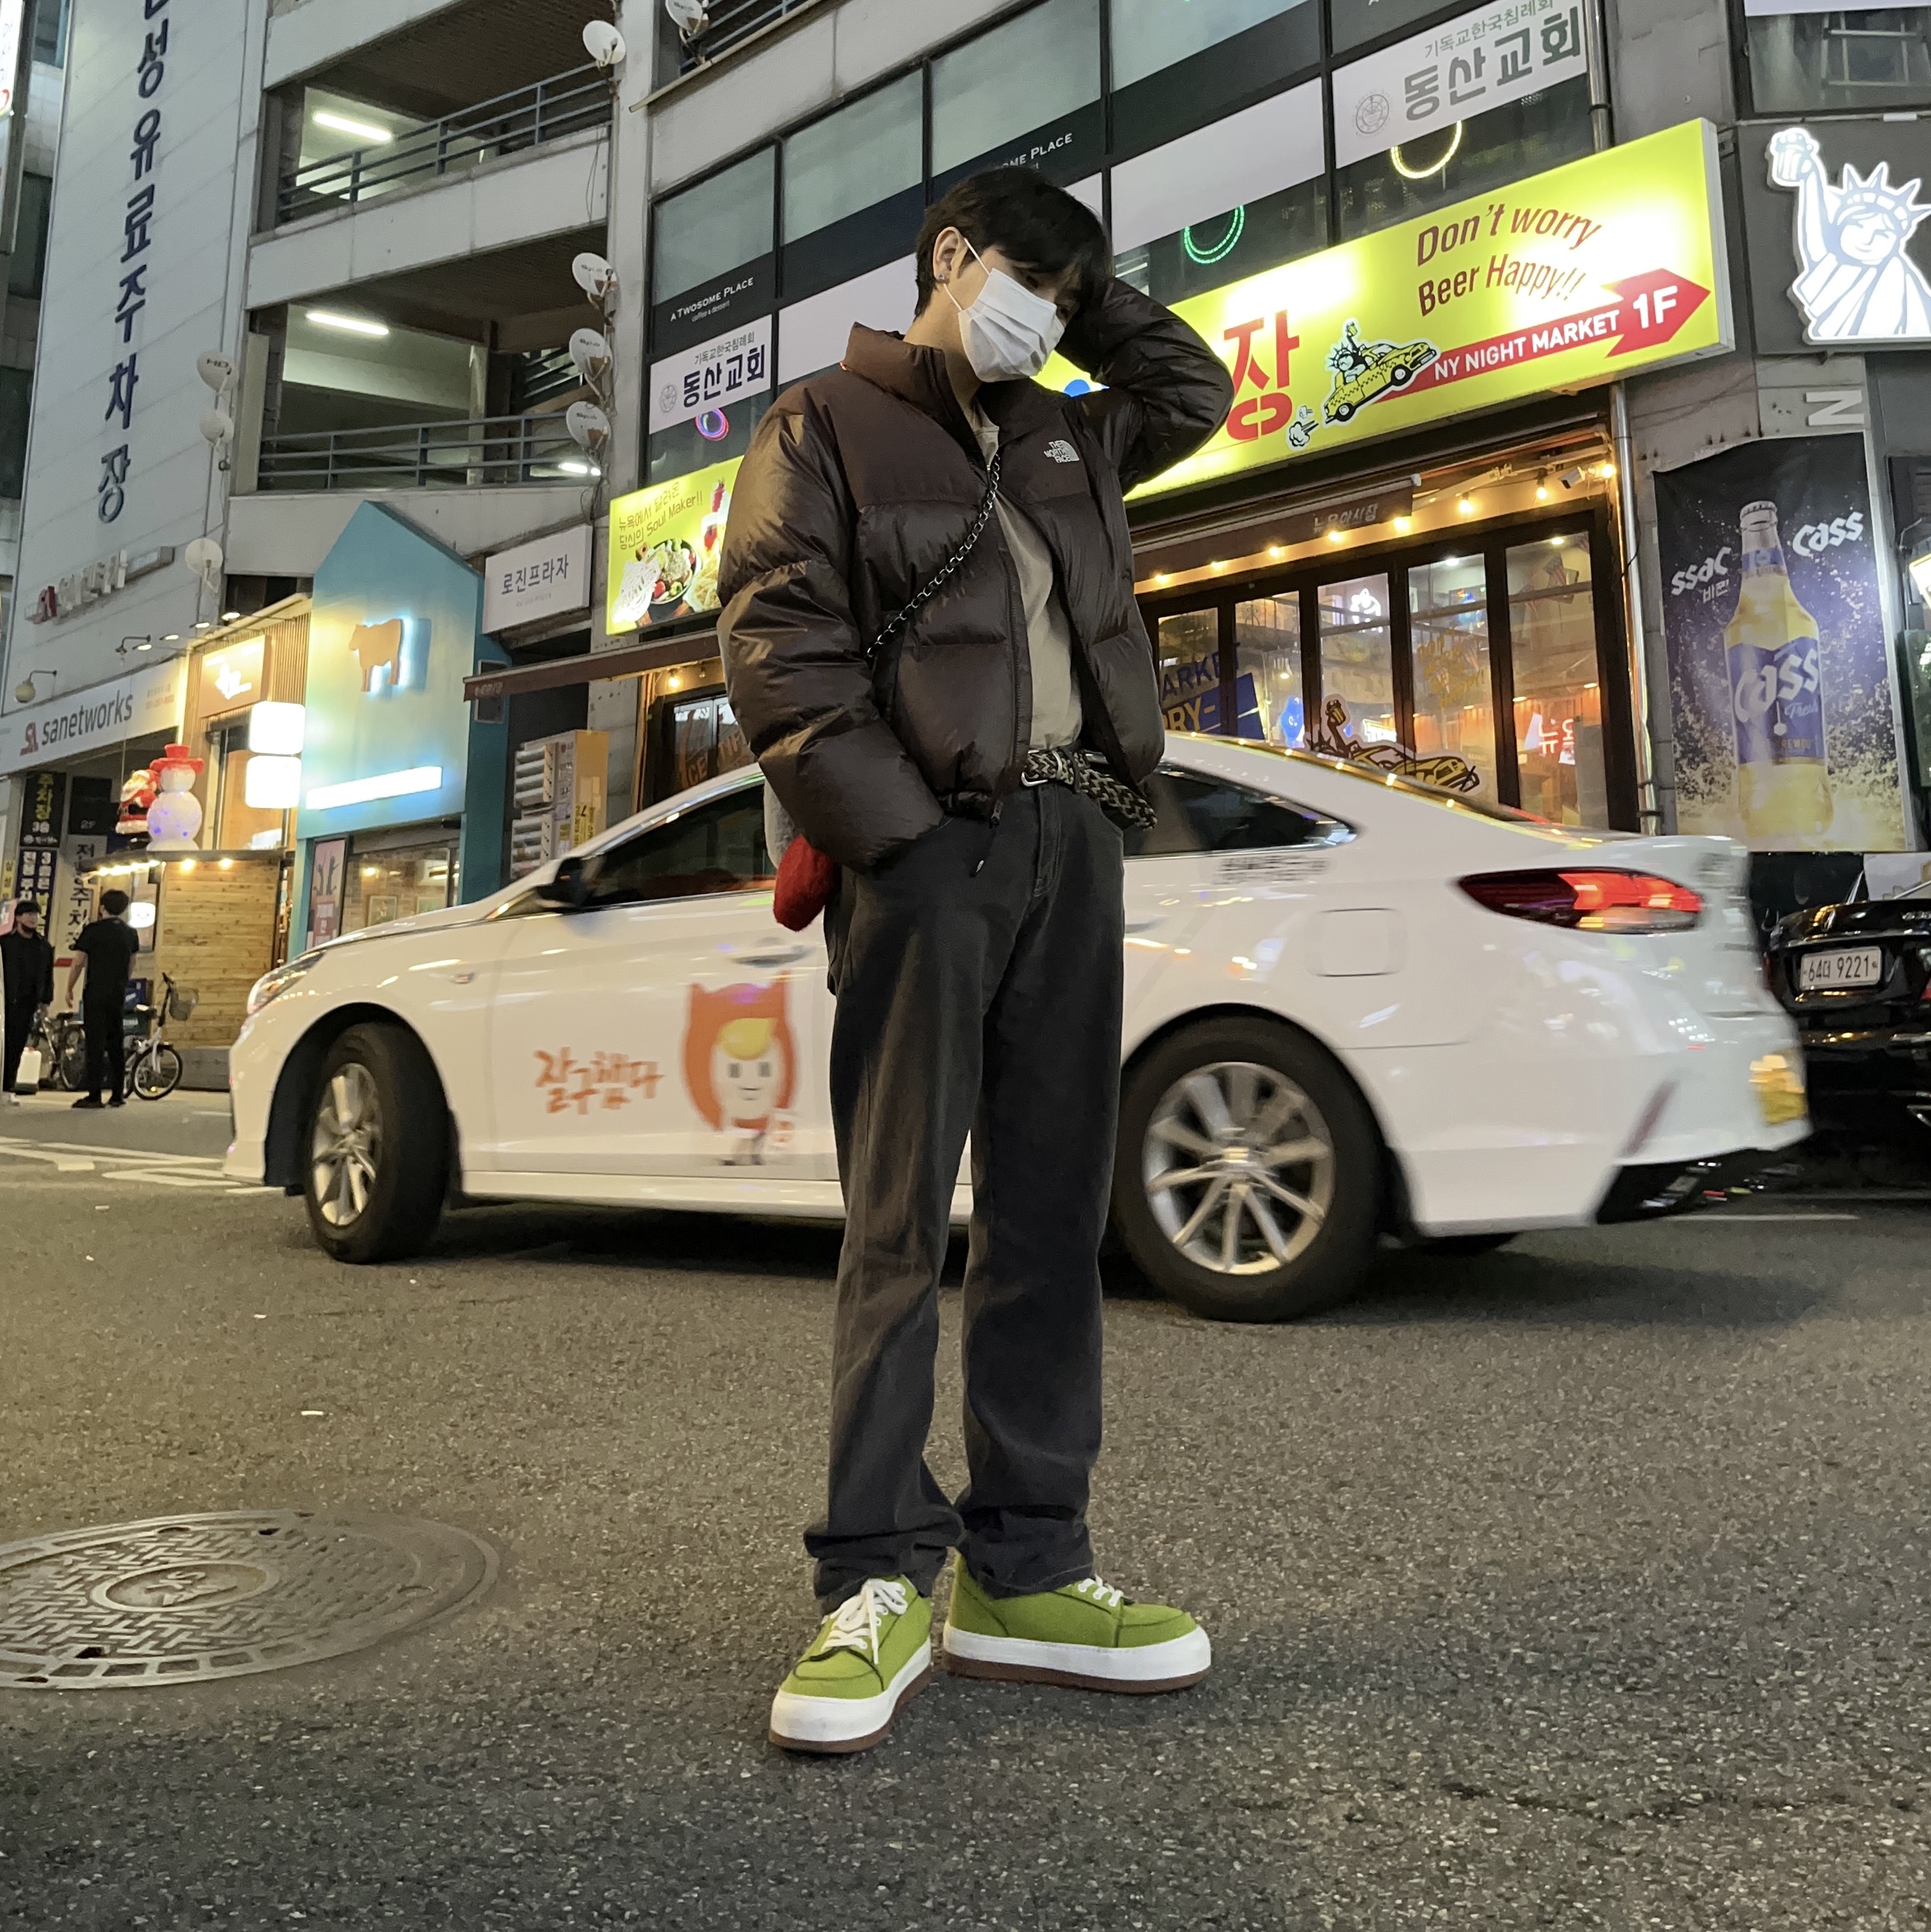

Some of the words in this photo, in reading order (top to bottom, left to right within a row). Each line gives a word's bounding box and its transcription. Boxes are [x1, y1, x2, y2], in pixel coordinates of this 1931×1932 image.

[1404, 6, 1581, 121] 동산교회
[1030, 132, 1073, 160] PLACE
[1417, 203, 1506, 267] Don't
[1510, 208, 1603, 250] worry
[670, 312, 677, 322] A
[723, 277, 755, 298] PLACE
[1418, 266, 1480, 317] Beer
[1485, 254, 1586, 301] Happy!!
[693, 331, 755, 365] 기독교한국침례회
[1434, 356, 1460, 381] NY
[1465, 338, 1527, 372] NIGHT
[1531, 309, 1620, 358] MARKET
[1632, 285, 1678, 329] 1F
[683, 344, 766, 409] 동산교회
[1043, 448, 1067, 458] NORTH
[1048, 440, 1063, 449] THE
[1054, 454, 1072, 464] FACE
[619, 507, 652, 531] 뉴욕에서
[619, 528, 644, 551] 당신의
[646, 513, 666, 537] Soul
[669, 491, 703, 521] Maker!!
[501, 554, 570, 595] 로진프라자
[42, 690, 133, 746] sanetworks
[1836, 955, 1869, 978] 9221
